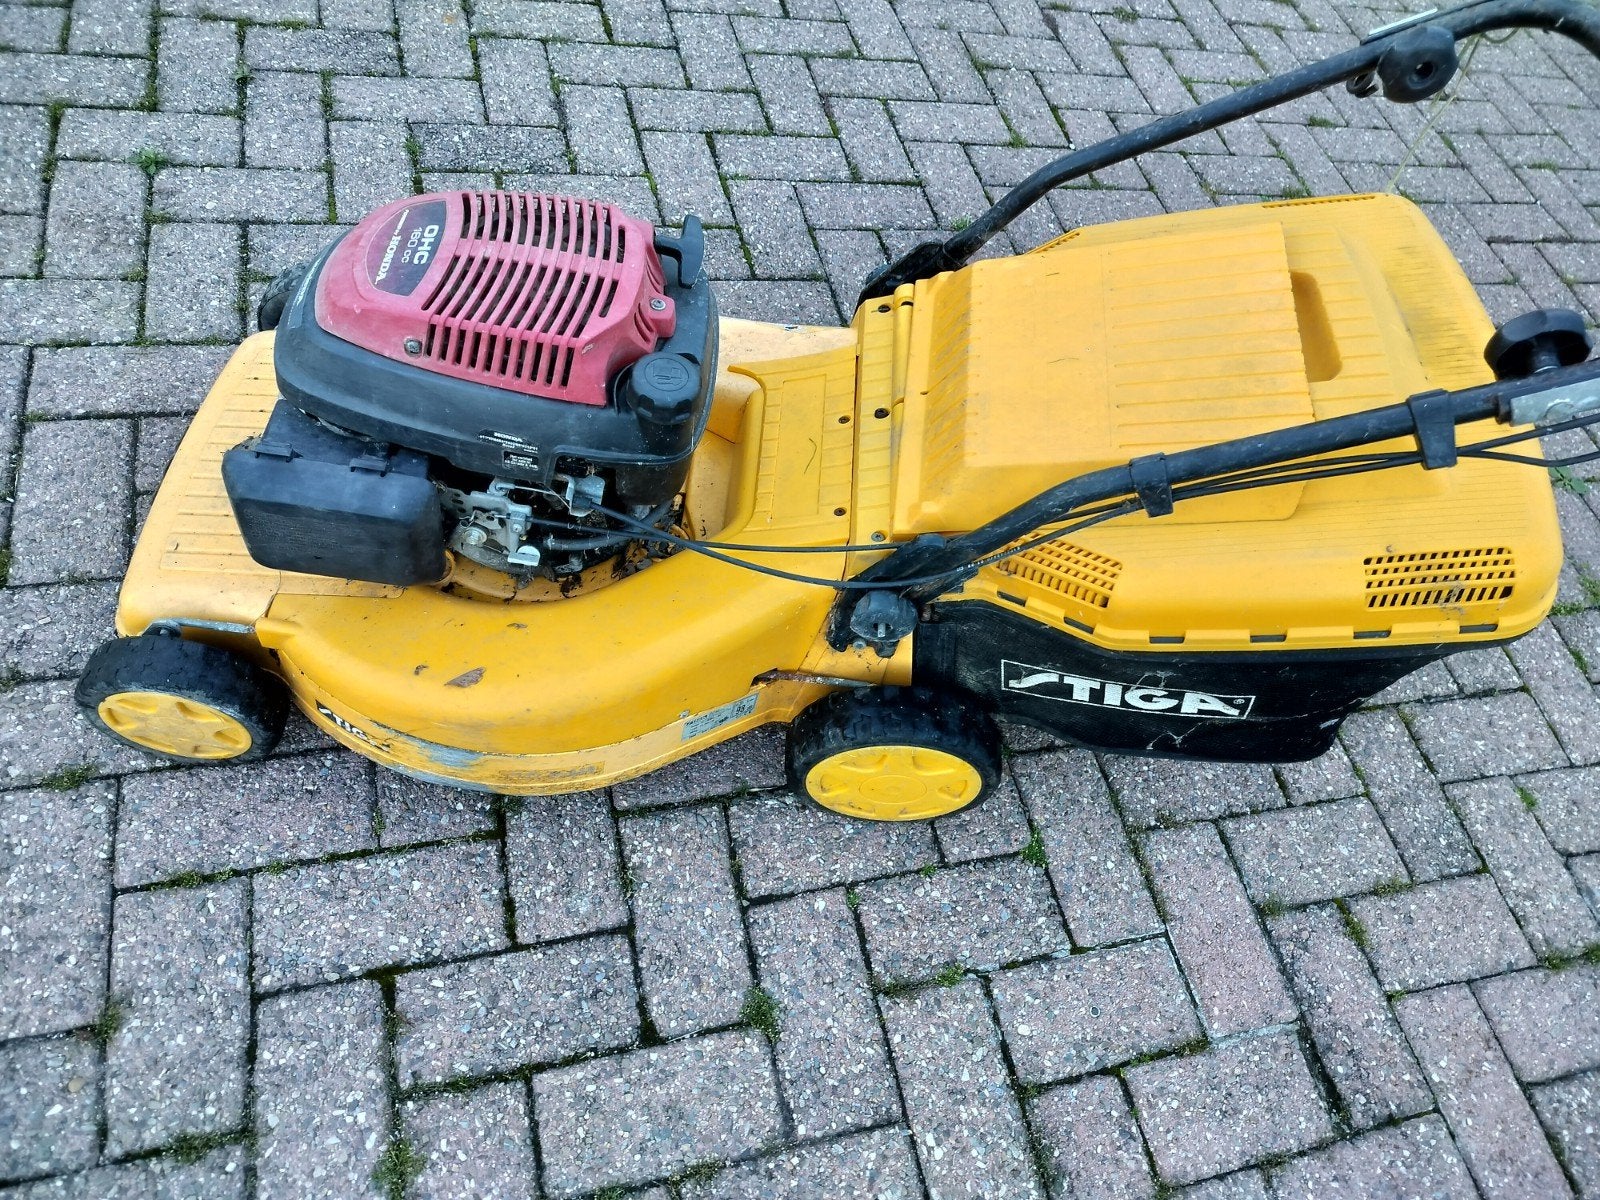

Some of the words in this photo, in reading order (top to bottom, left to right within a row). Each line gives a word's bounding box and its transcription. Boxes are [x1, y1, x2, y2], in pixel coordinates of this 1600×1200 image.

[374, 235, 402, 285] HONDA
[413, 225, 439, 264] OHC
[1008, 673, 1240, 716] STIGA
[318, 707, 387, 750] STIG
